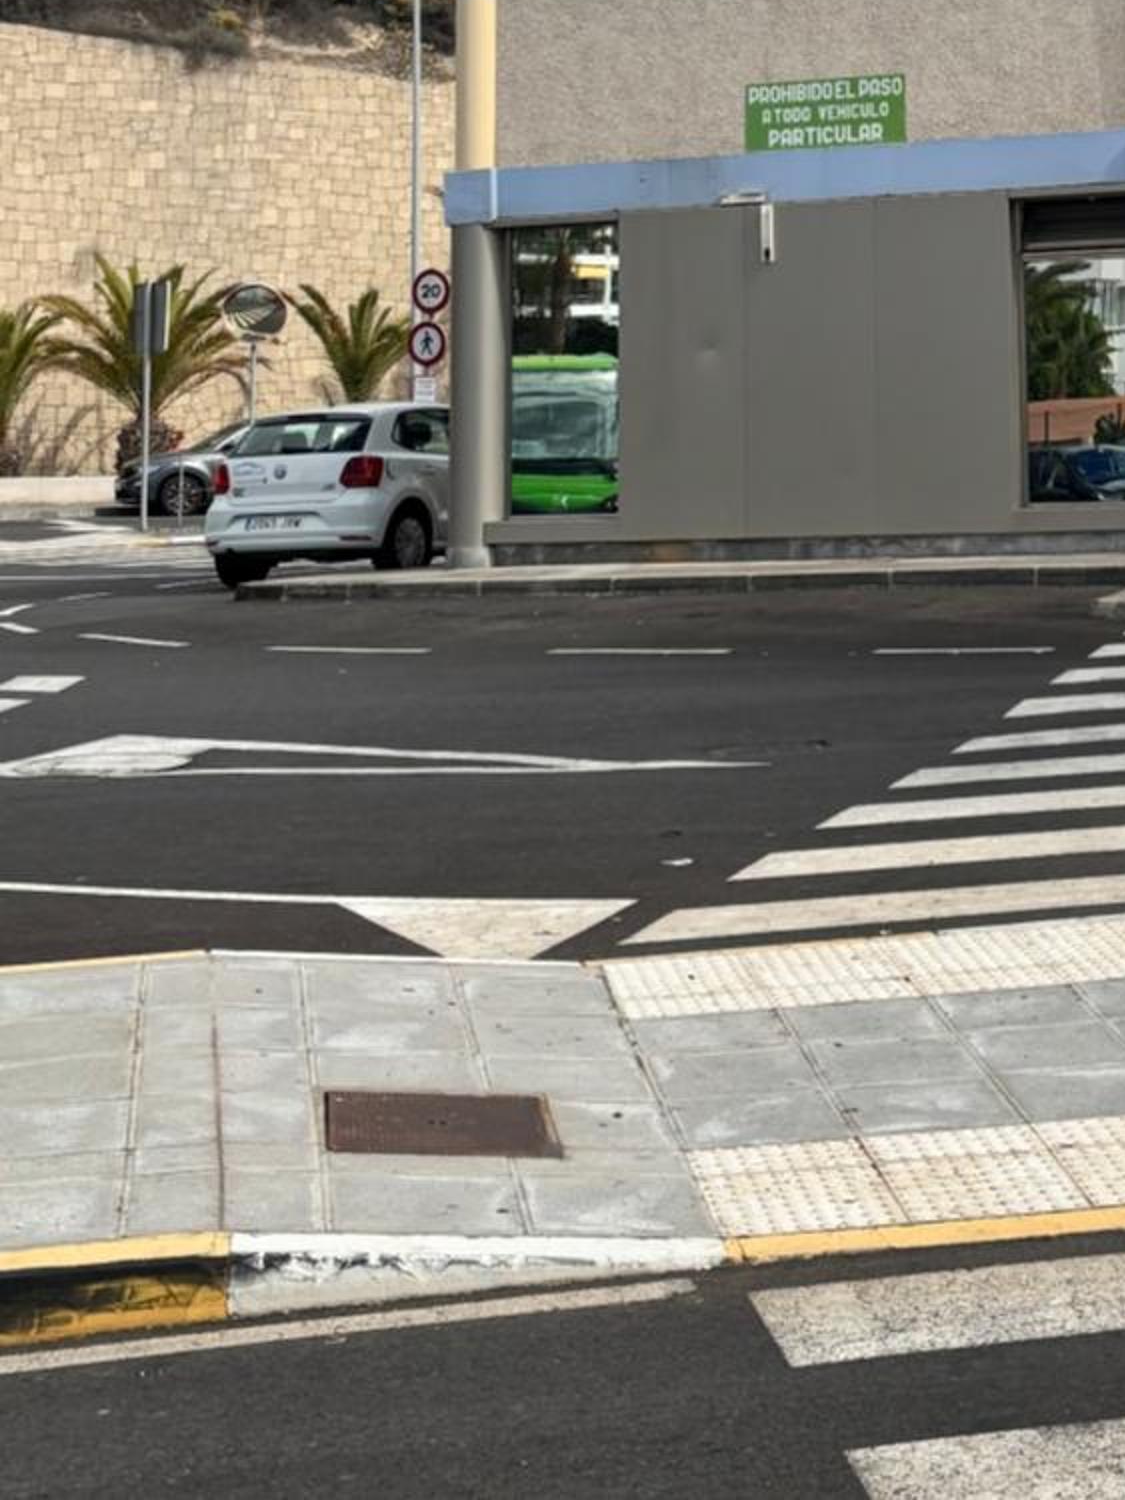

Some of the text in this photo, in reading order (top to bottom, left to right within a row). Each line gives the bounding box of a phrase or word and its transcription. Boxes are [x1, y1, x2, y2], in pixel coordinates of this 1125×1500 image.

[749, 77, 903, 105] PROHIBIDO EL PASO
[774, 106, 812, 124] TODO
[818, 101, 890, 121] VEHICULO
[768, 123, 884, 148] PARTICULAR
[421, 283, 442, 299] 20
